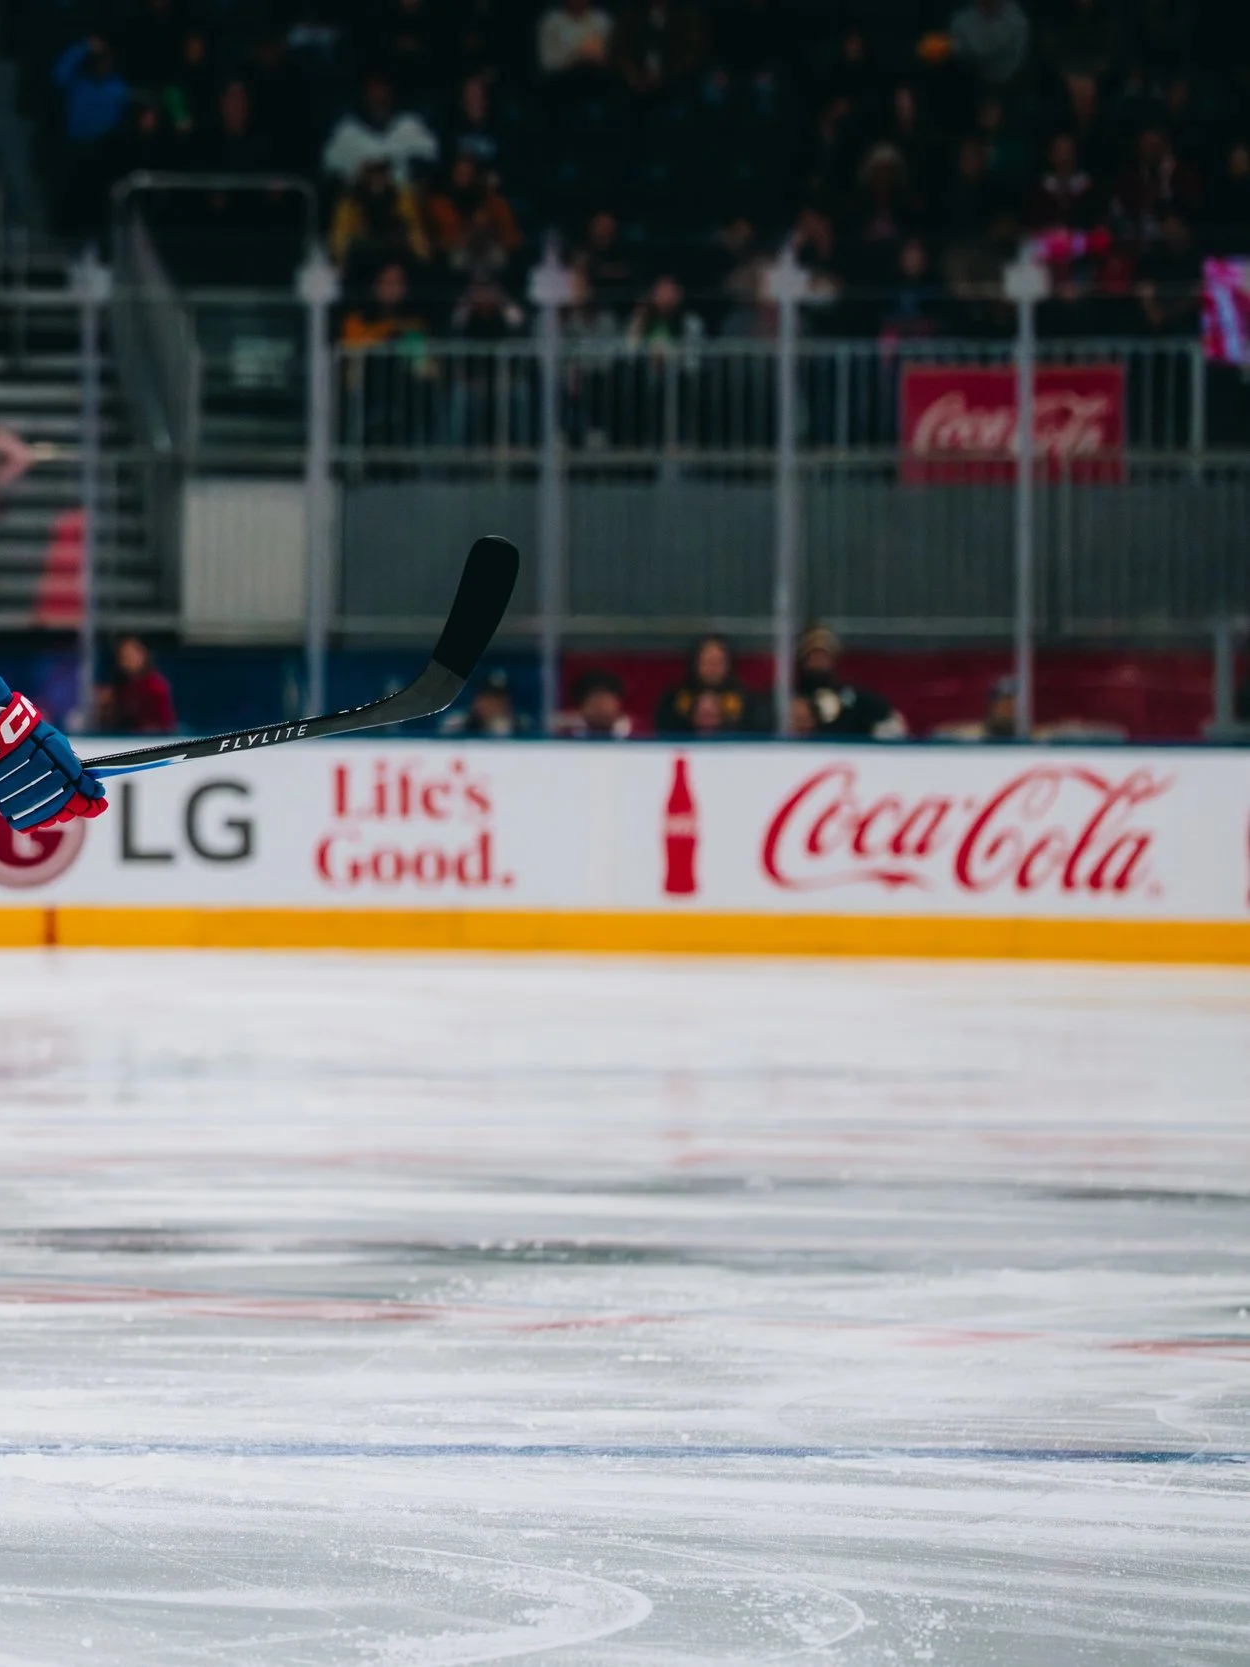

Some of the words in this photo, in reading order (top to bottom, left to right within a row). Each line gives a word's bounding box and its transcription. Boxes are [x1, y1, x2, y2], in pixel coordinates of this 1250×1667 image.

[218, 724, 308, 752] FLYLITE
[332, 757, 491, 820] Life's
[120, 778, 256, 863] LG
[760, 762, 1177, 894] Coca-Cola
[314, 829, 516, 888] Good.
